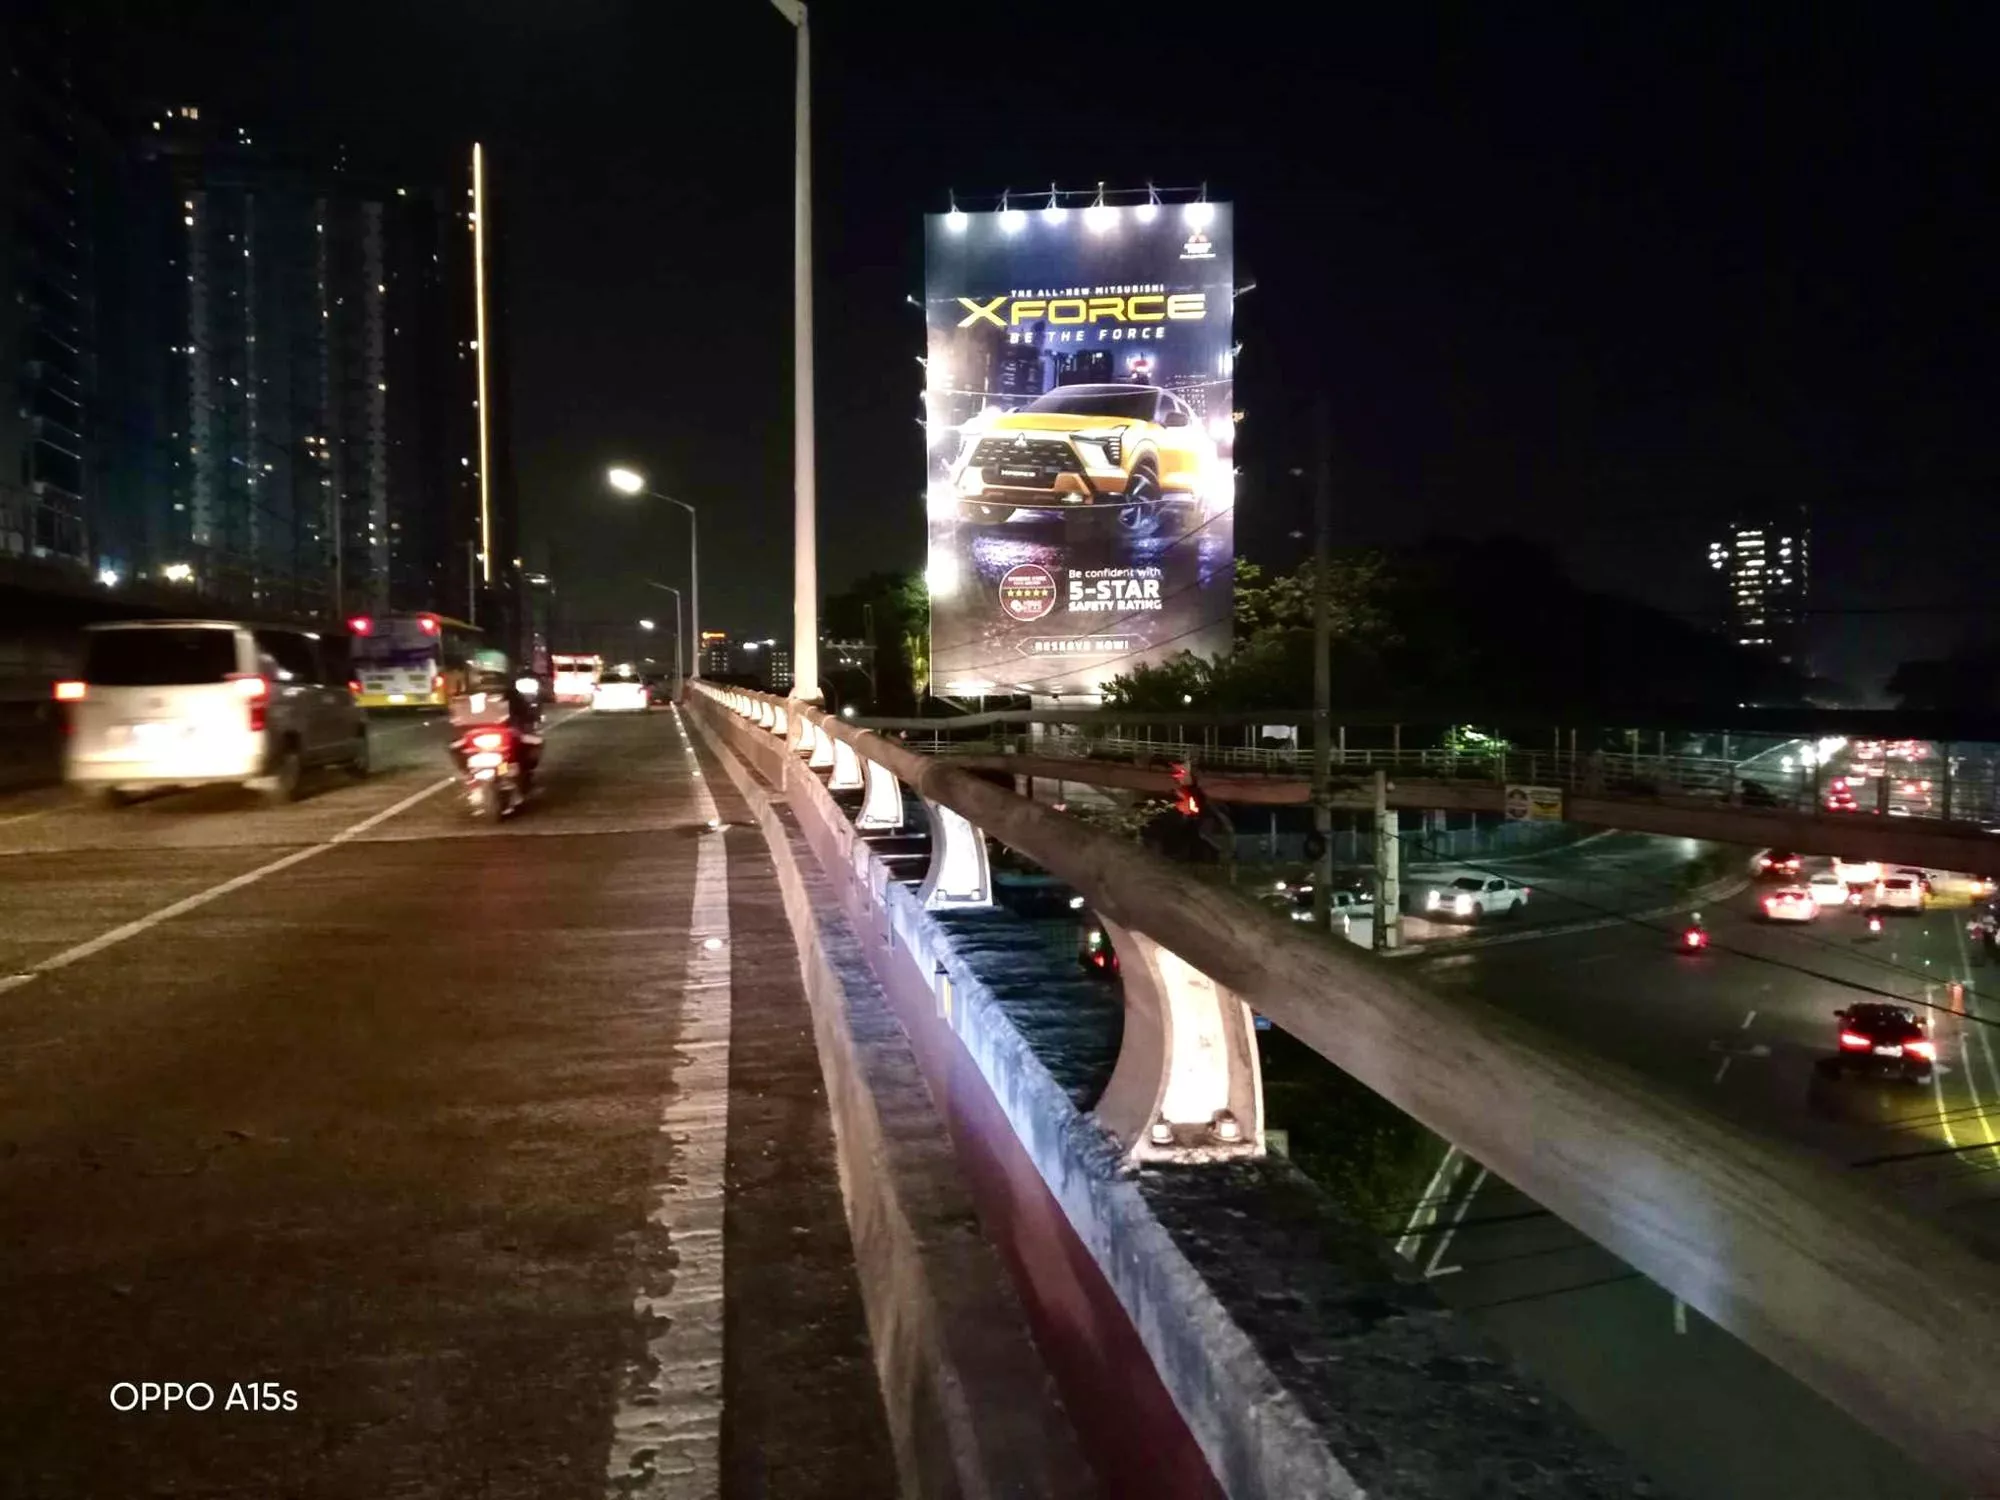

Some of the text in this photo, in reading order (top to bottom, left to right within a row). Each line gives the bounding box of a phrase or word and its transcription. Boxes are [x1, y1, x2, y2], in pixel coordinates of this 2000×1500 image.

[1011, 284, 1165, 298] THE ALL-NEW MITSUBISHI
[957, 293, 1206, 327] XFORCE
[1009, 327, 1165, 344] BE THE FORCE
[1068, 566, 1161, 578] Be confident with
[1069, 580, 1160, 600] 5-STAR
[1068, 600, 1162, 611] SAFETY RATING
